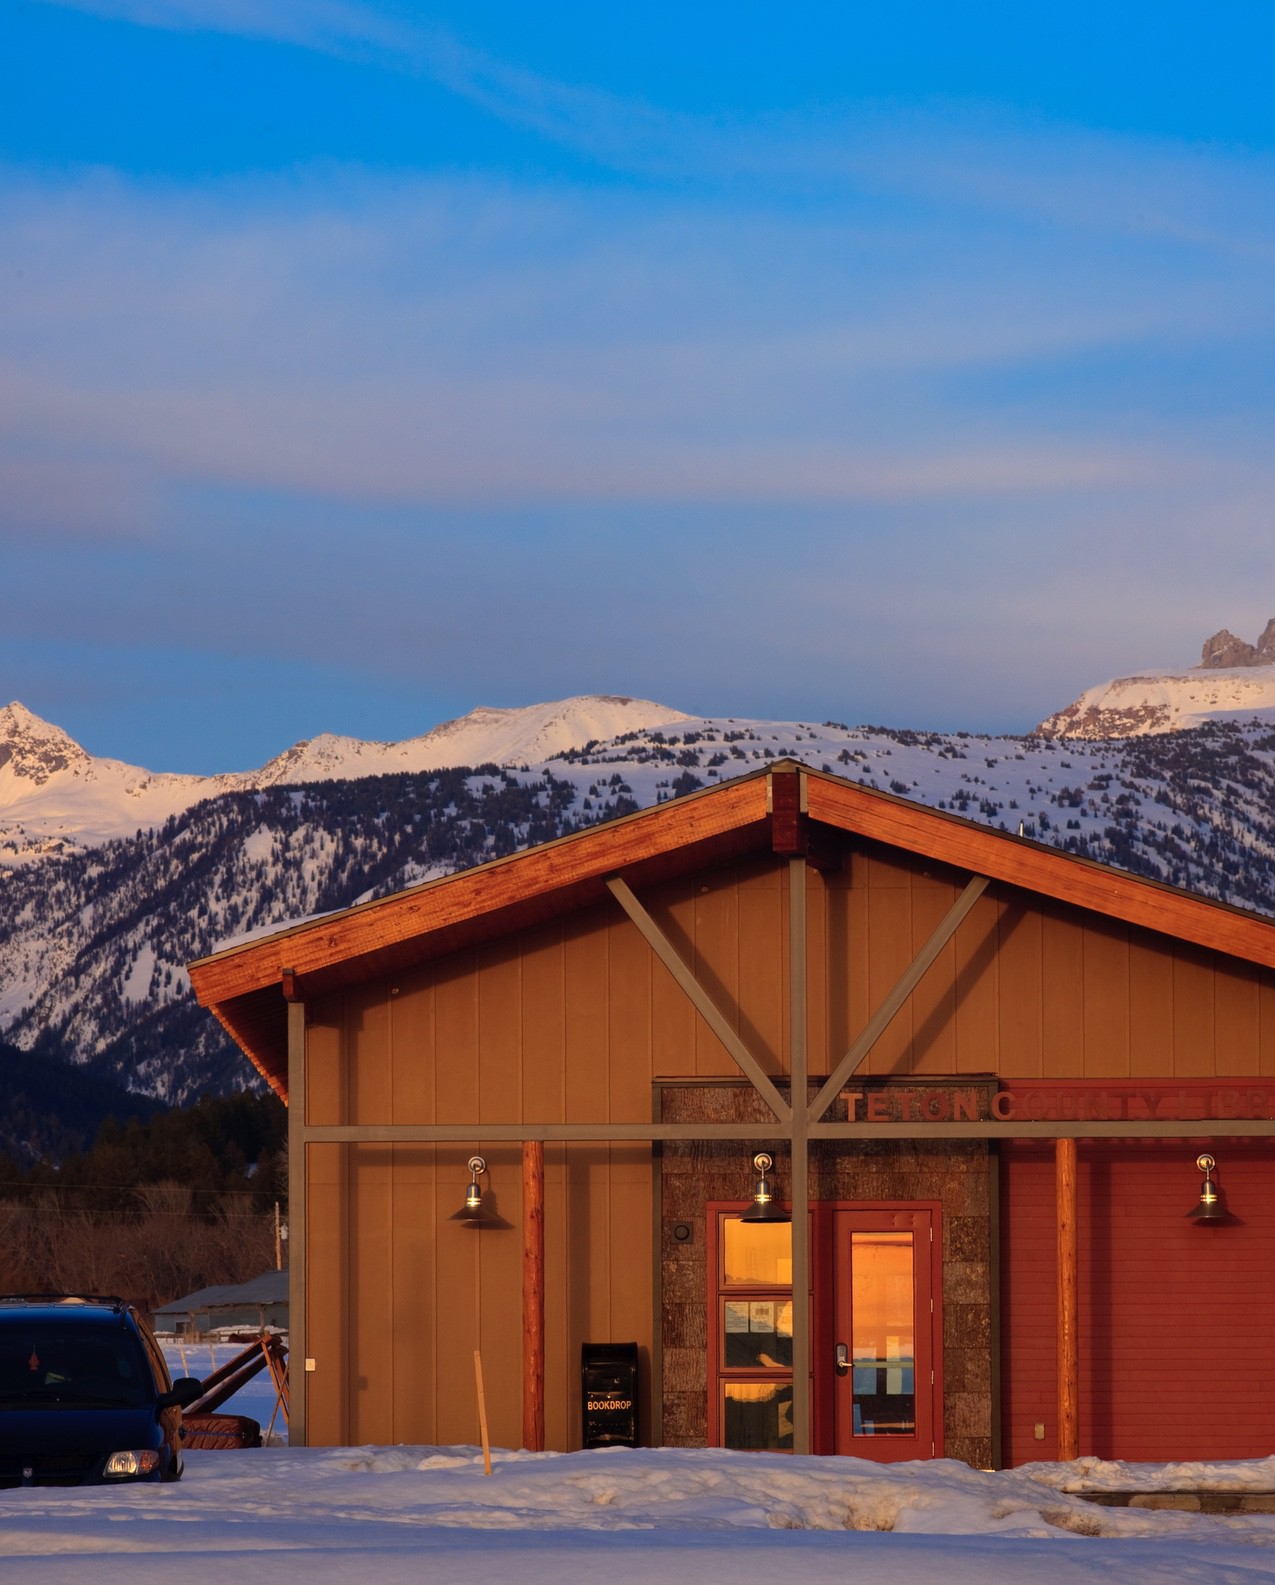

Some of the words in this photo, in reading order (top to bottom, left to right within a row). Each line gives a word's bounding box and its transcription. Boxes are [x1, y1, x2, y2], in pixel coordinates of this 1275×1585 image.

[839, 1092, 977, 1121] TETON
[991, 1092, 1165, 1121] COUNTY
[587, 1401, 632, 1411] BOOKDROP
